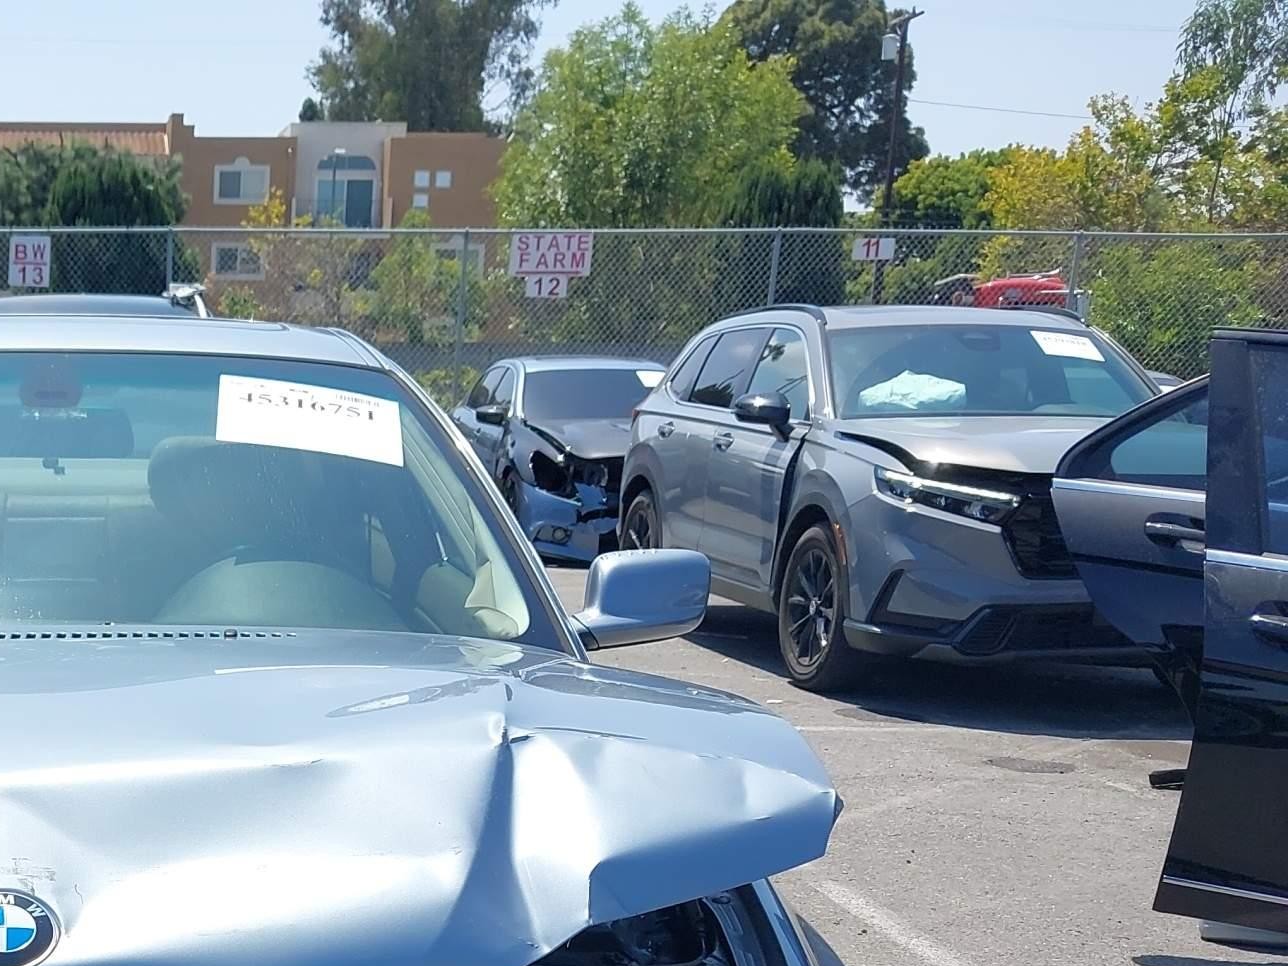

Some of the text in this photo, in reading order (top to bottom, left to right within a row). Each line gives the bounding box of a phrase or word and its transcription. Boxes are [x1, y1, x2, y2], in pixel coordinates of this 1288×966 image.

[14, 243, 46, 260] BW
[517, 234, 590, 252] STATE
[862, 239, 881, 258] 11
[518, 252, 585, 269] FARM
[17, 266, 44, 285] 13
[533, 277, 561, 296] 12
[239, 392, 375, 422] 45316751
